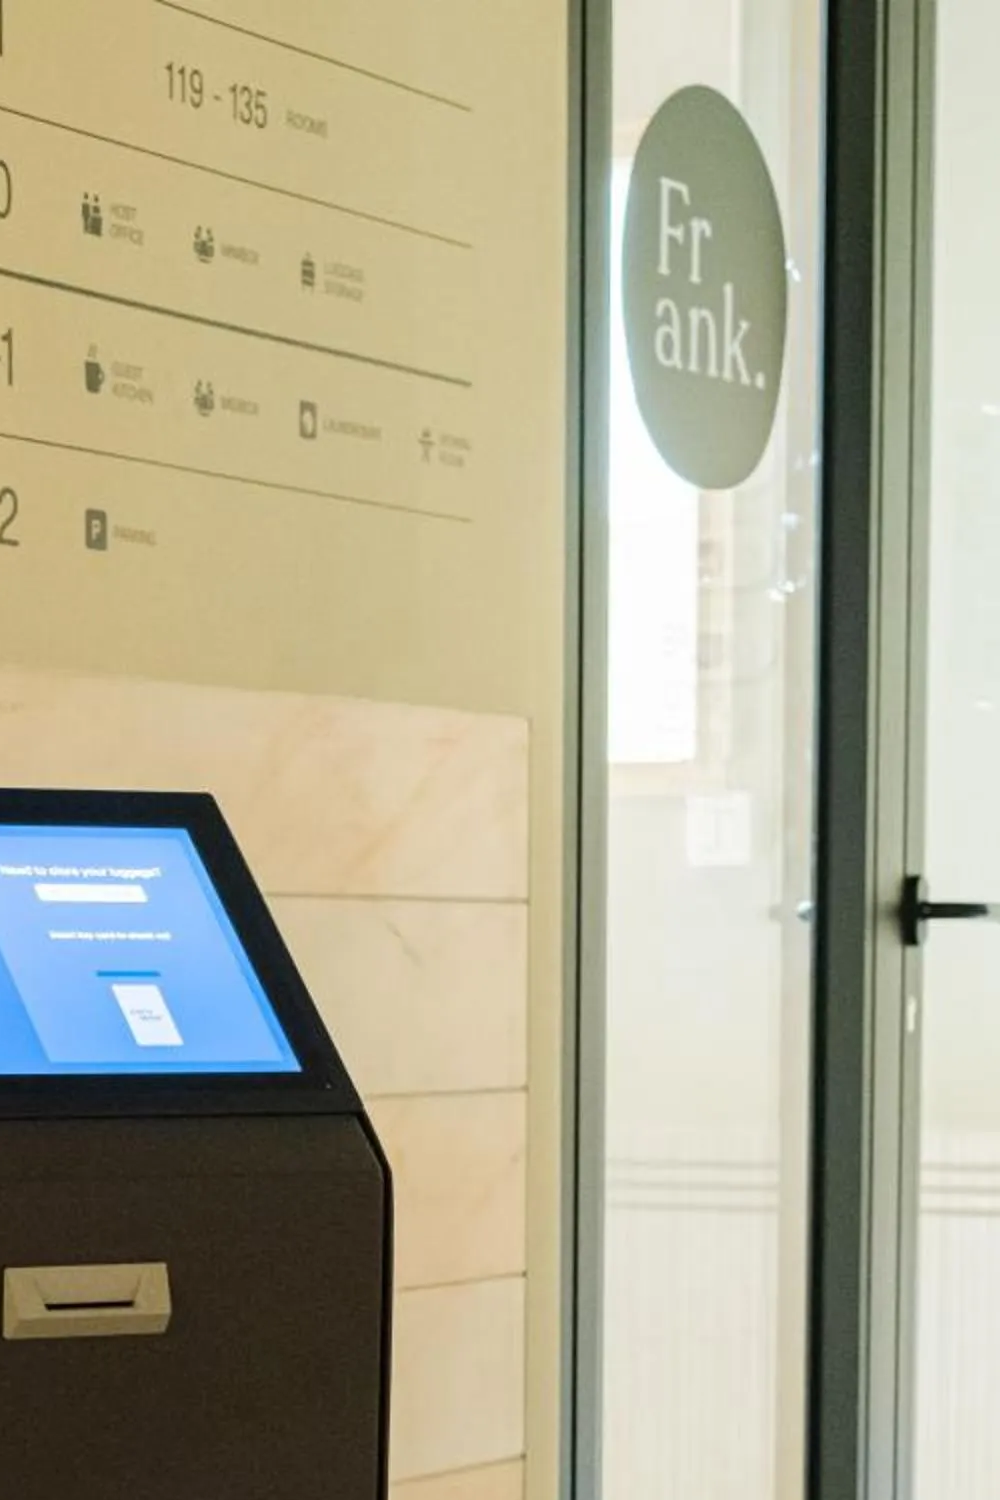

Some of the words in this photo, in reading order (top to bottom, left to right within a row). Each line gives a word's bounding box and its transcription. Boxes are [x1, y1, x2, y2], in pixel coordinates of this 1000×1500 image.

[163, 61, 204, 109] 119
[227, 81, 269, 130] 135
[656, 175, 713, 284] Fr
[654, 281, 767, 391] ank.
